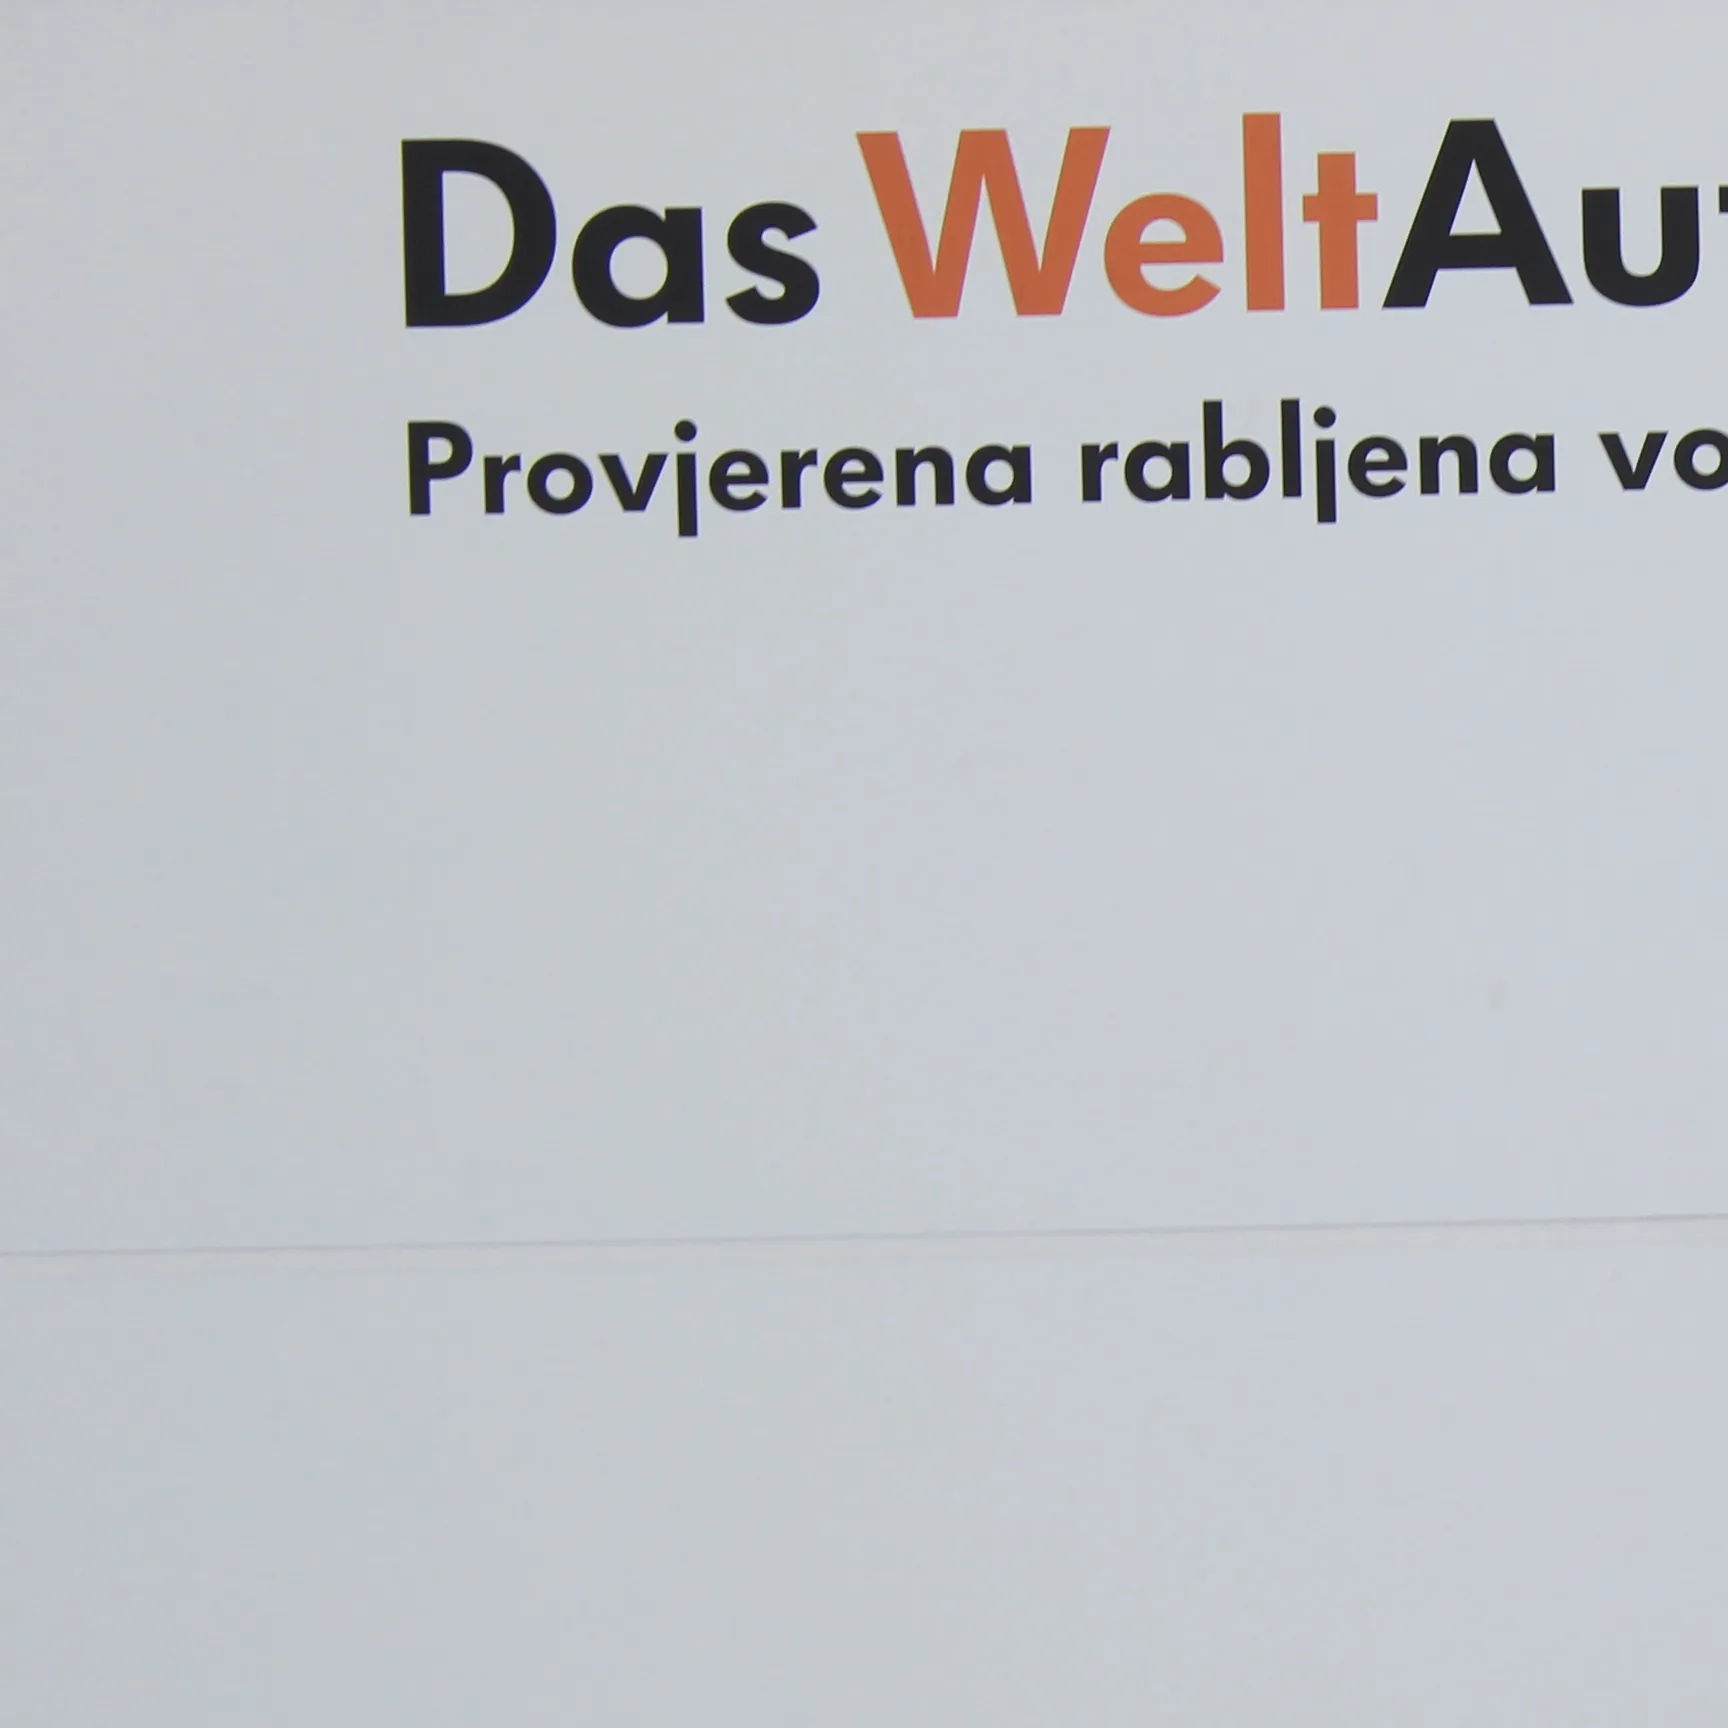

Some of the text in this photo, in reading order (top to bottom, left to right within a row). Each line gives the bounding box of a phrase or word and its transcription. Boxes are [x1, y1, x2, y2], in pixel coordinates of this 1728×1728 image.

[402, 139, 819, 328] Das
[408, 420, 1031, 536] Provjerena
[1082, 399, 1555, 523] rabljena
